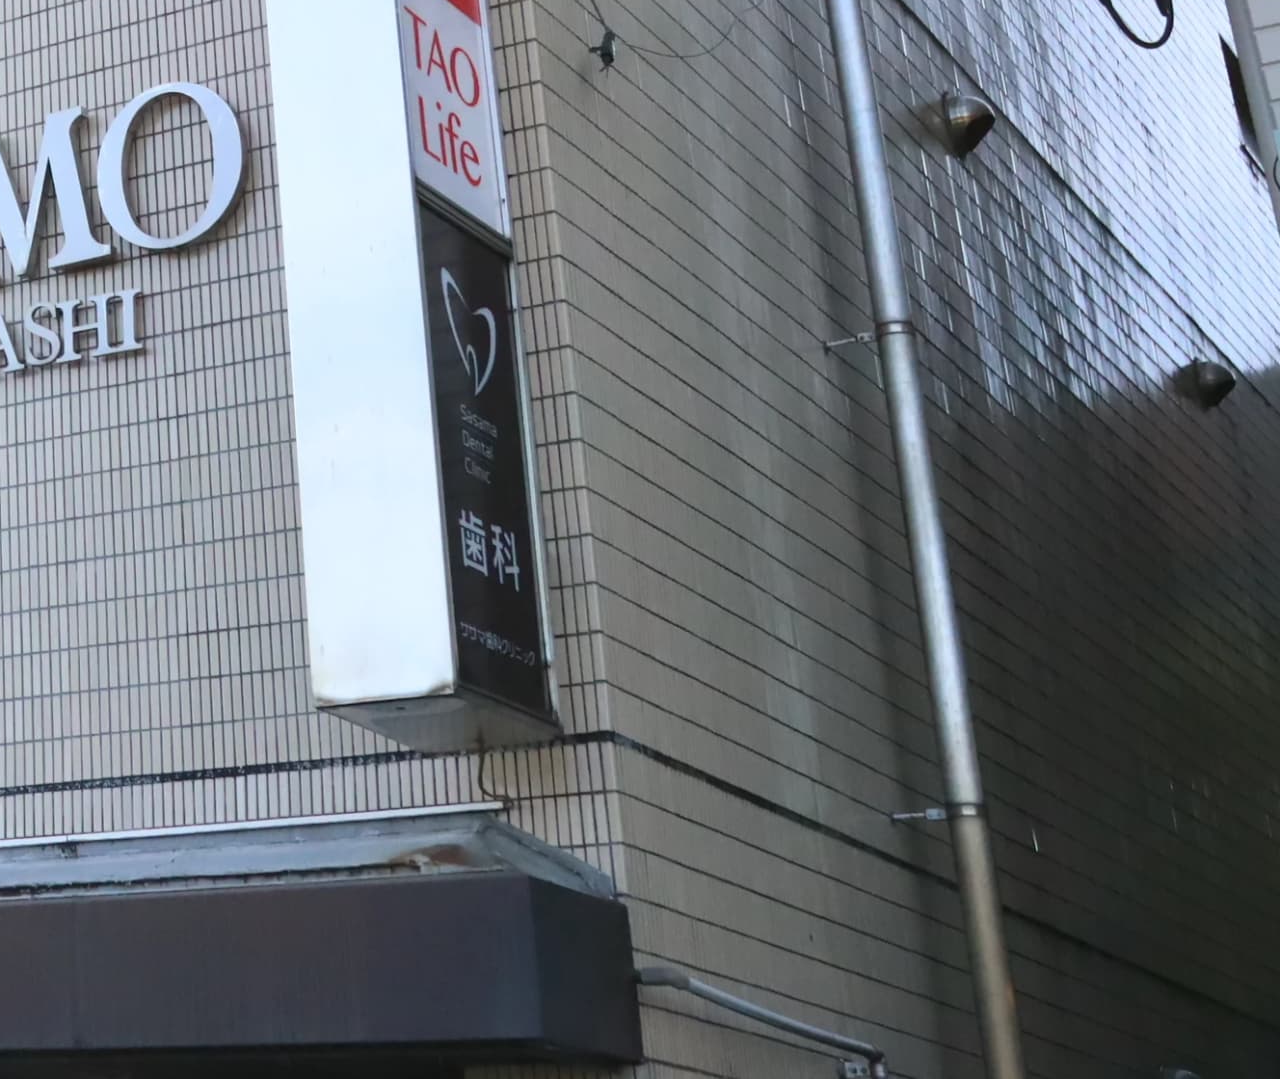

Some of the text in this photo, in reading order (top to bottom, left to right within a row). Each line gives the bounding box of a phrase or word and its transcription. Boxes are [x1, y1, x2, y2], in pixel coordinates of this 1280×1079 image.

[403, 5, 480, 108] TAO
[418, 95, 482, 187] Life
[460, 404, 497, 438] Sasama
[462, 428, 494, 460] Dental
[464, 456, 491, 484] Clinic
[458, 509, 520, 593] 歯科
